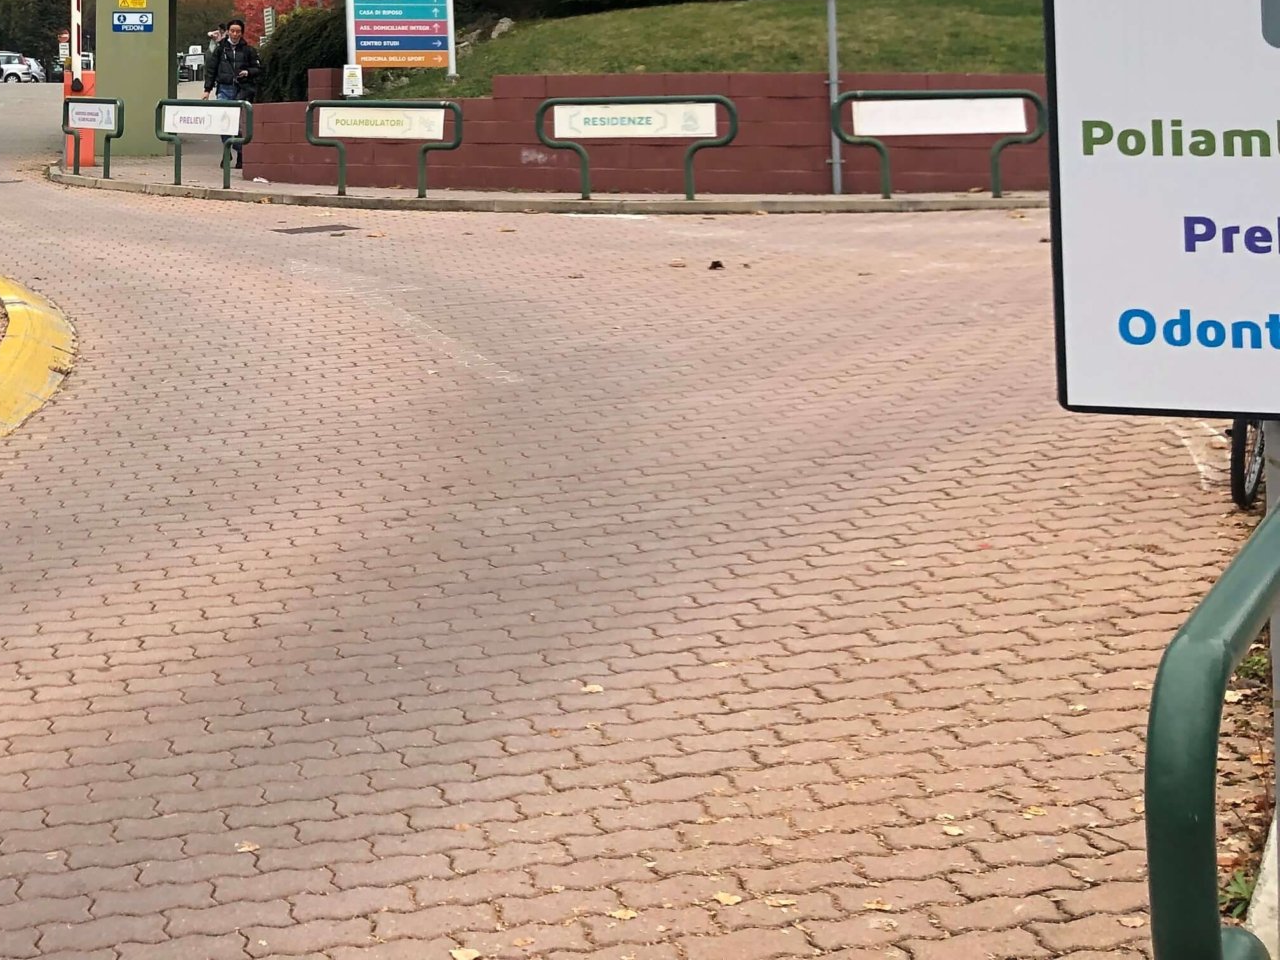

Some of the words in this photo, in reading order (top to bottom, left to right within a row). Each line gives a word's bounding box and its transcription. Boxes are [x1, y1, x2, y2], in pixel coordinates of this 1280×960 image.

[179, 116, 205, 125] PRELIEVI
[335, 118, 404, 127] POLIAMBULATORI
[583, 116, 653, 126] RESIDENZE
[1082, 119, 1280, 157] Poliam
[1183, 215, 1280, 254] Pre
